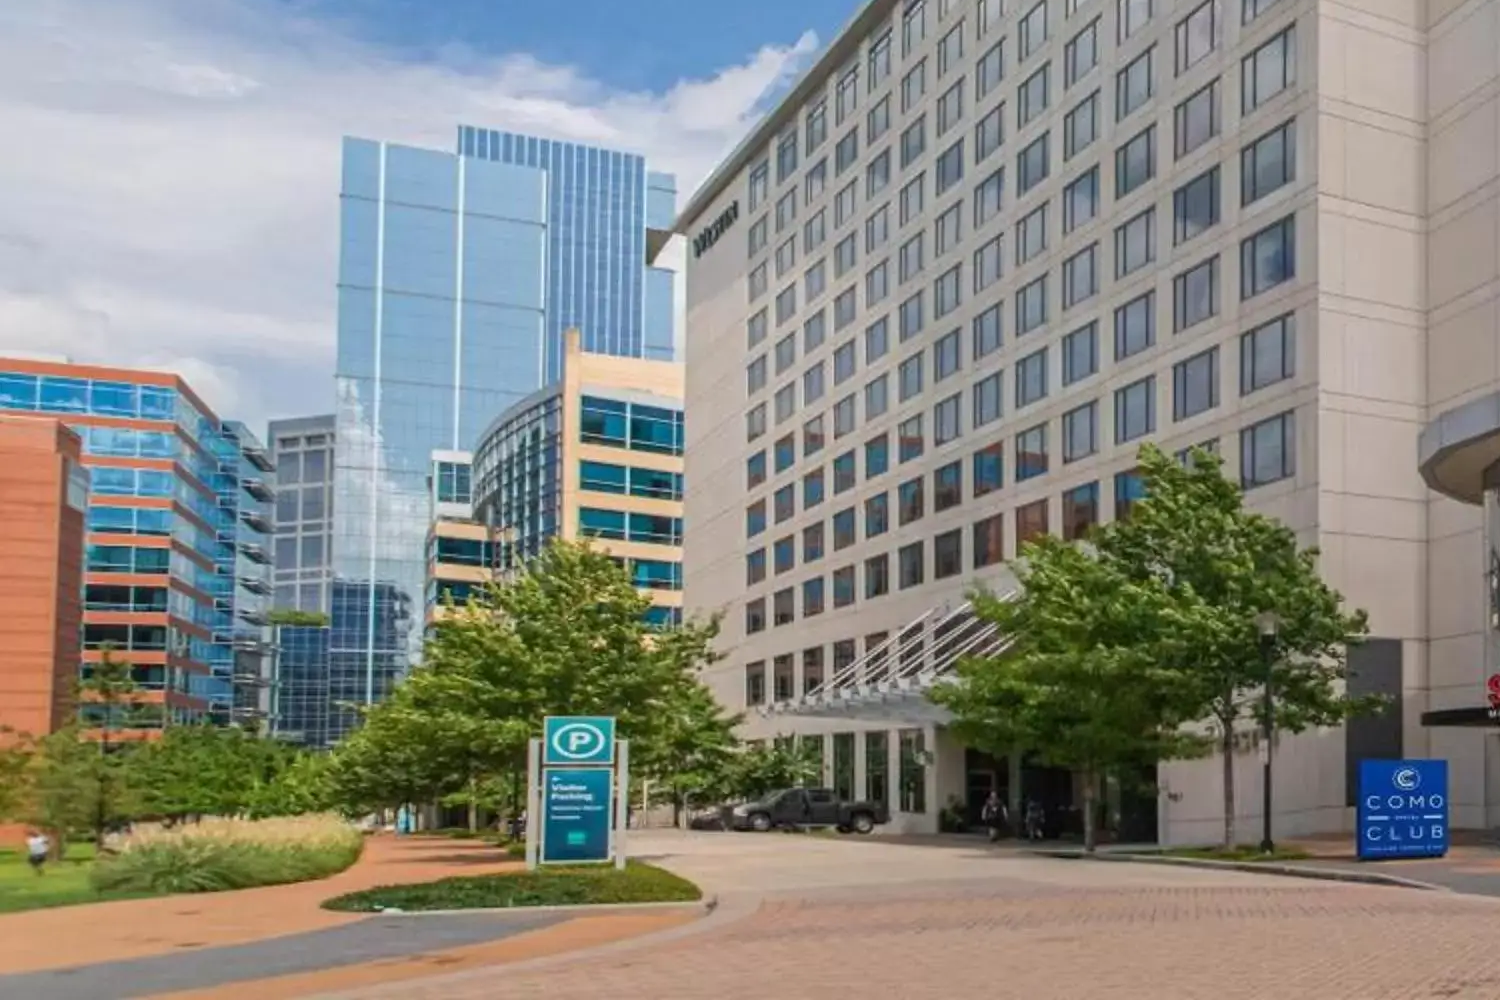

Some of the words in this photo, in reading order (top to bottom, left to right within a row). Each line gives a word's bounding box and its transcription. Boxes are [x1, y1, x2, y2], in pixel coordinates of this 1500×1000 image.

[568, 731, 592, 752] P
[1367, 794, 1443, 810] COMO
[1367, 824, 1443, 841] CLUB
